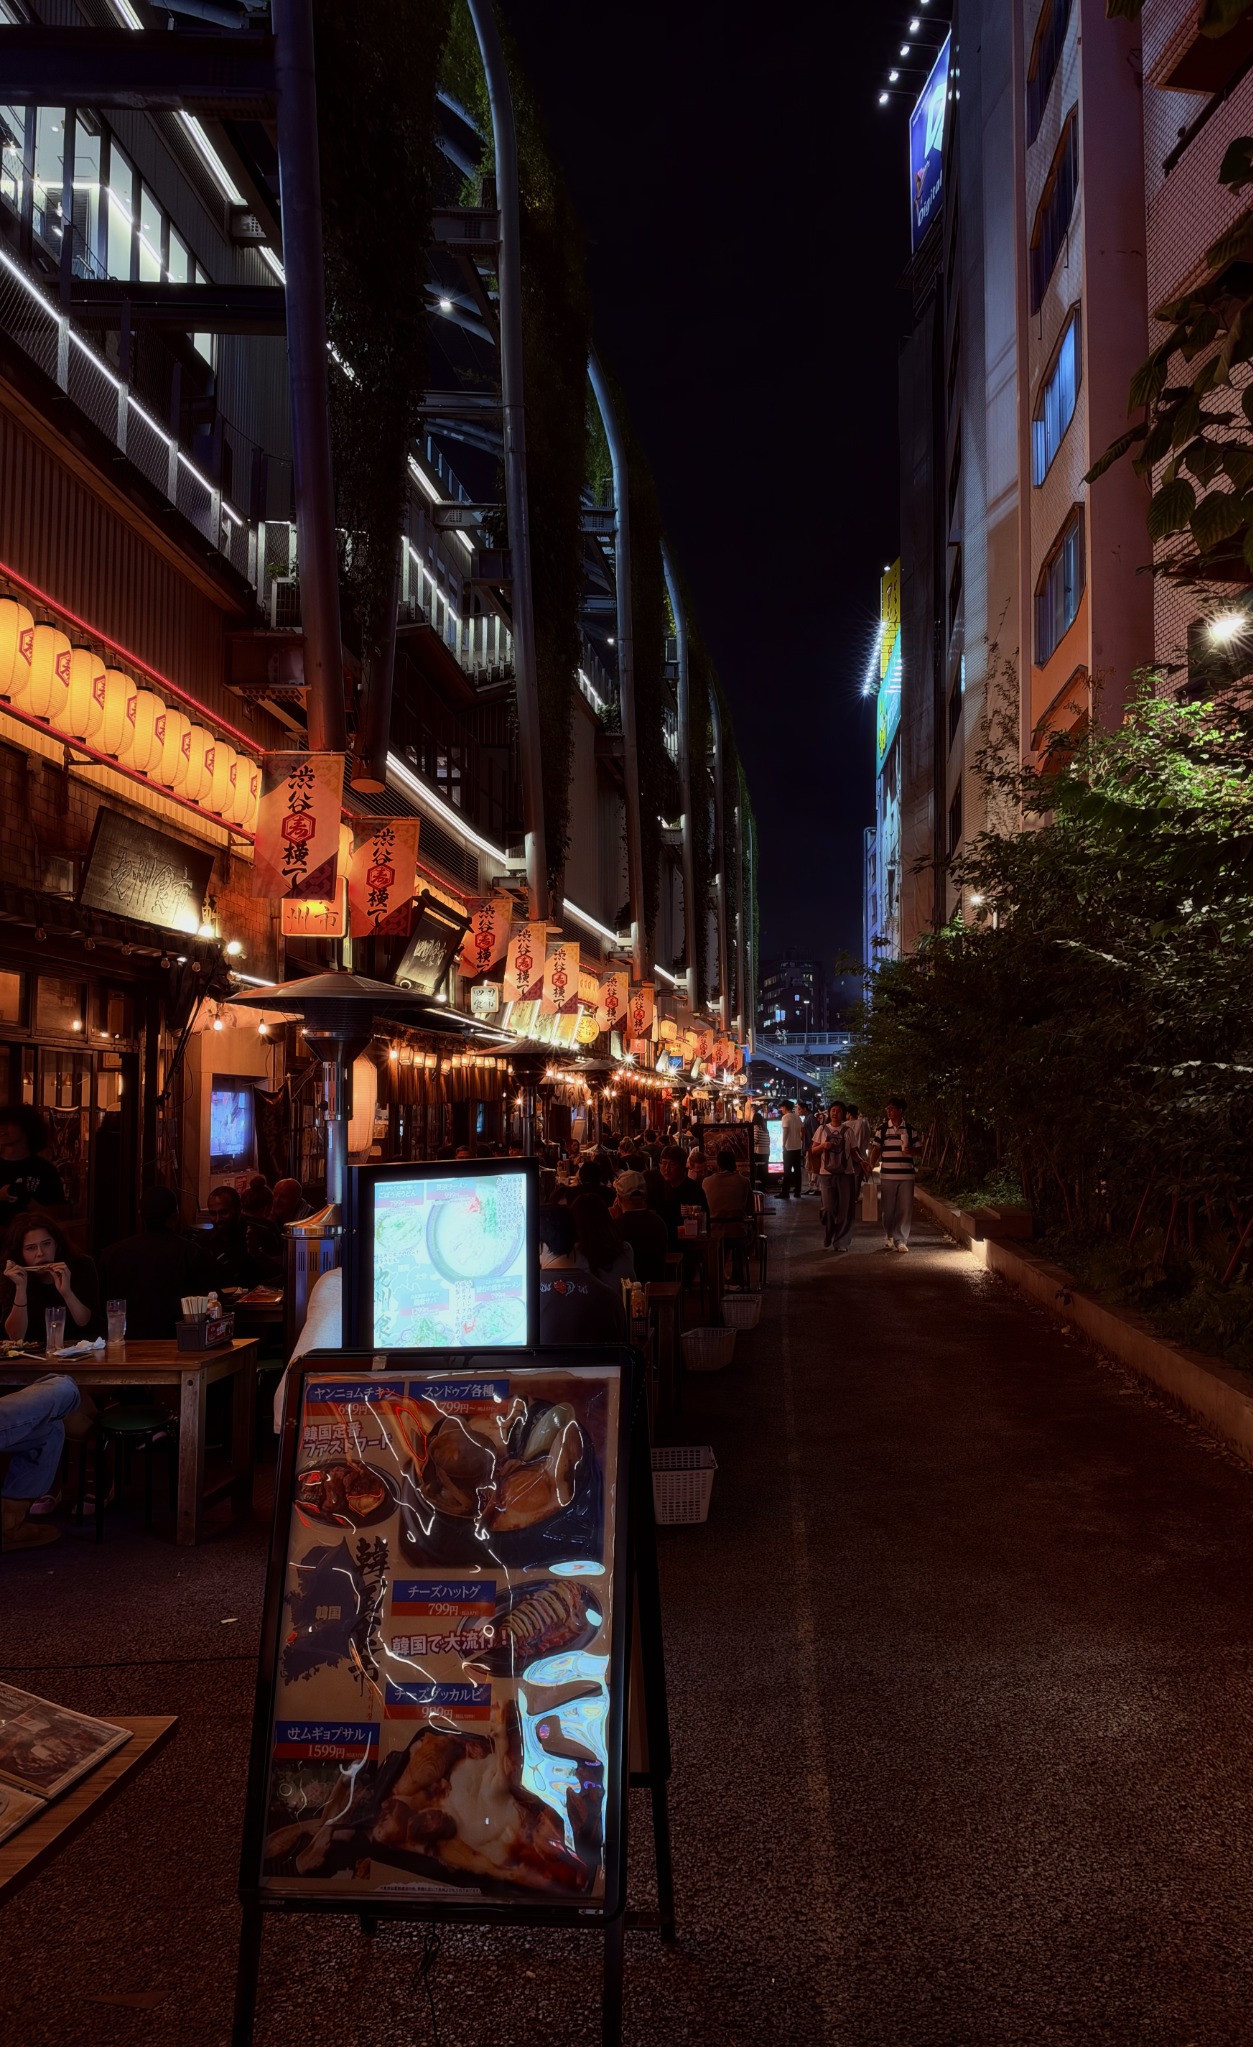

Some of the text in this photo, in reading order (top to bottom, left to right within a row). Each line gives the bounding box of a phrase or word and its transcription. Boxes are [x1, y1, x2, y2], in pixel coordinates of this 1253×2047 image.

[314, 1386, 397, 1400] ヤンニョムチキン
[303, 1421, 362, 1441] 韓国定番
[408, 1585, 481, 1598] チーズハットグ
[428, 1603, 459, 1616] 799円
[288, 1726, 366, 1742] サムギョプサル
[308, 1744, 346, 1759] 1599円
